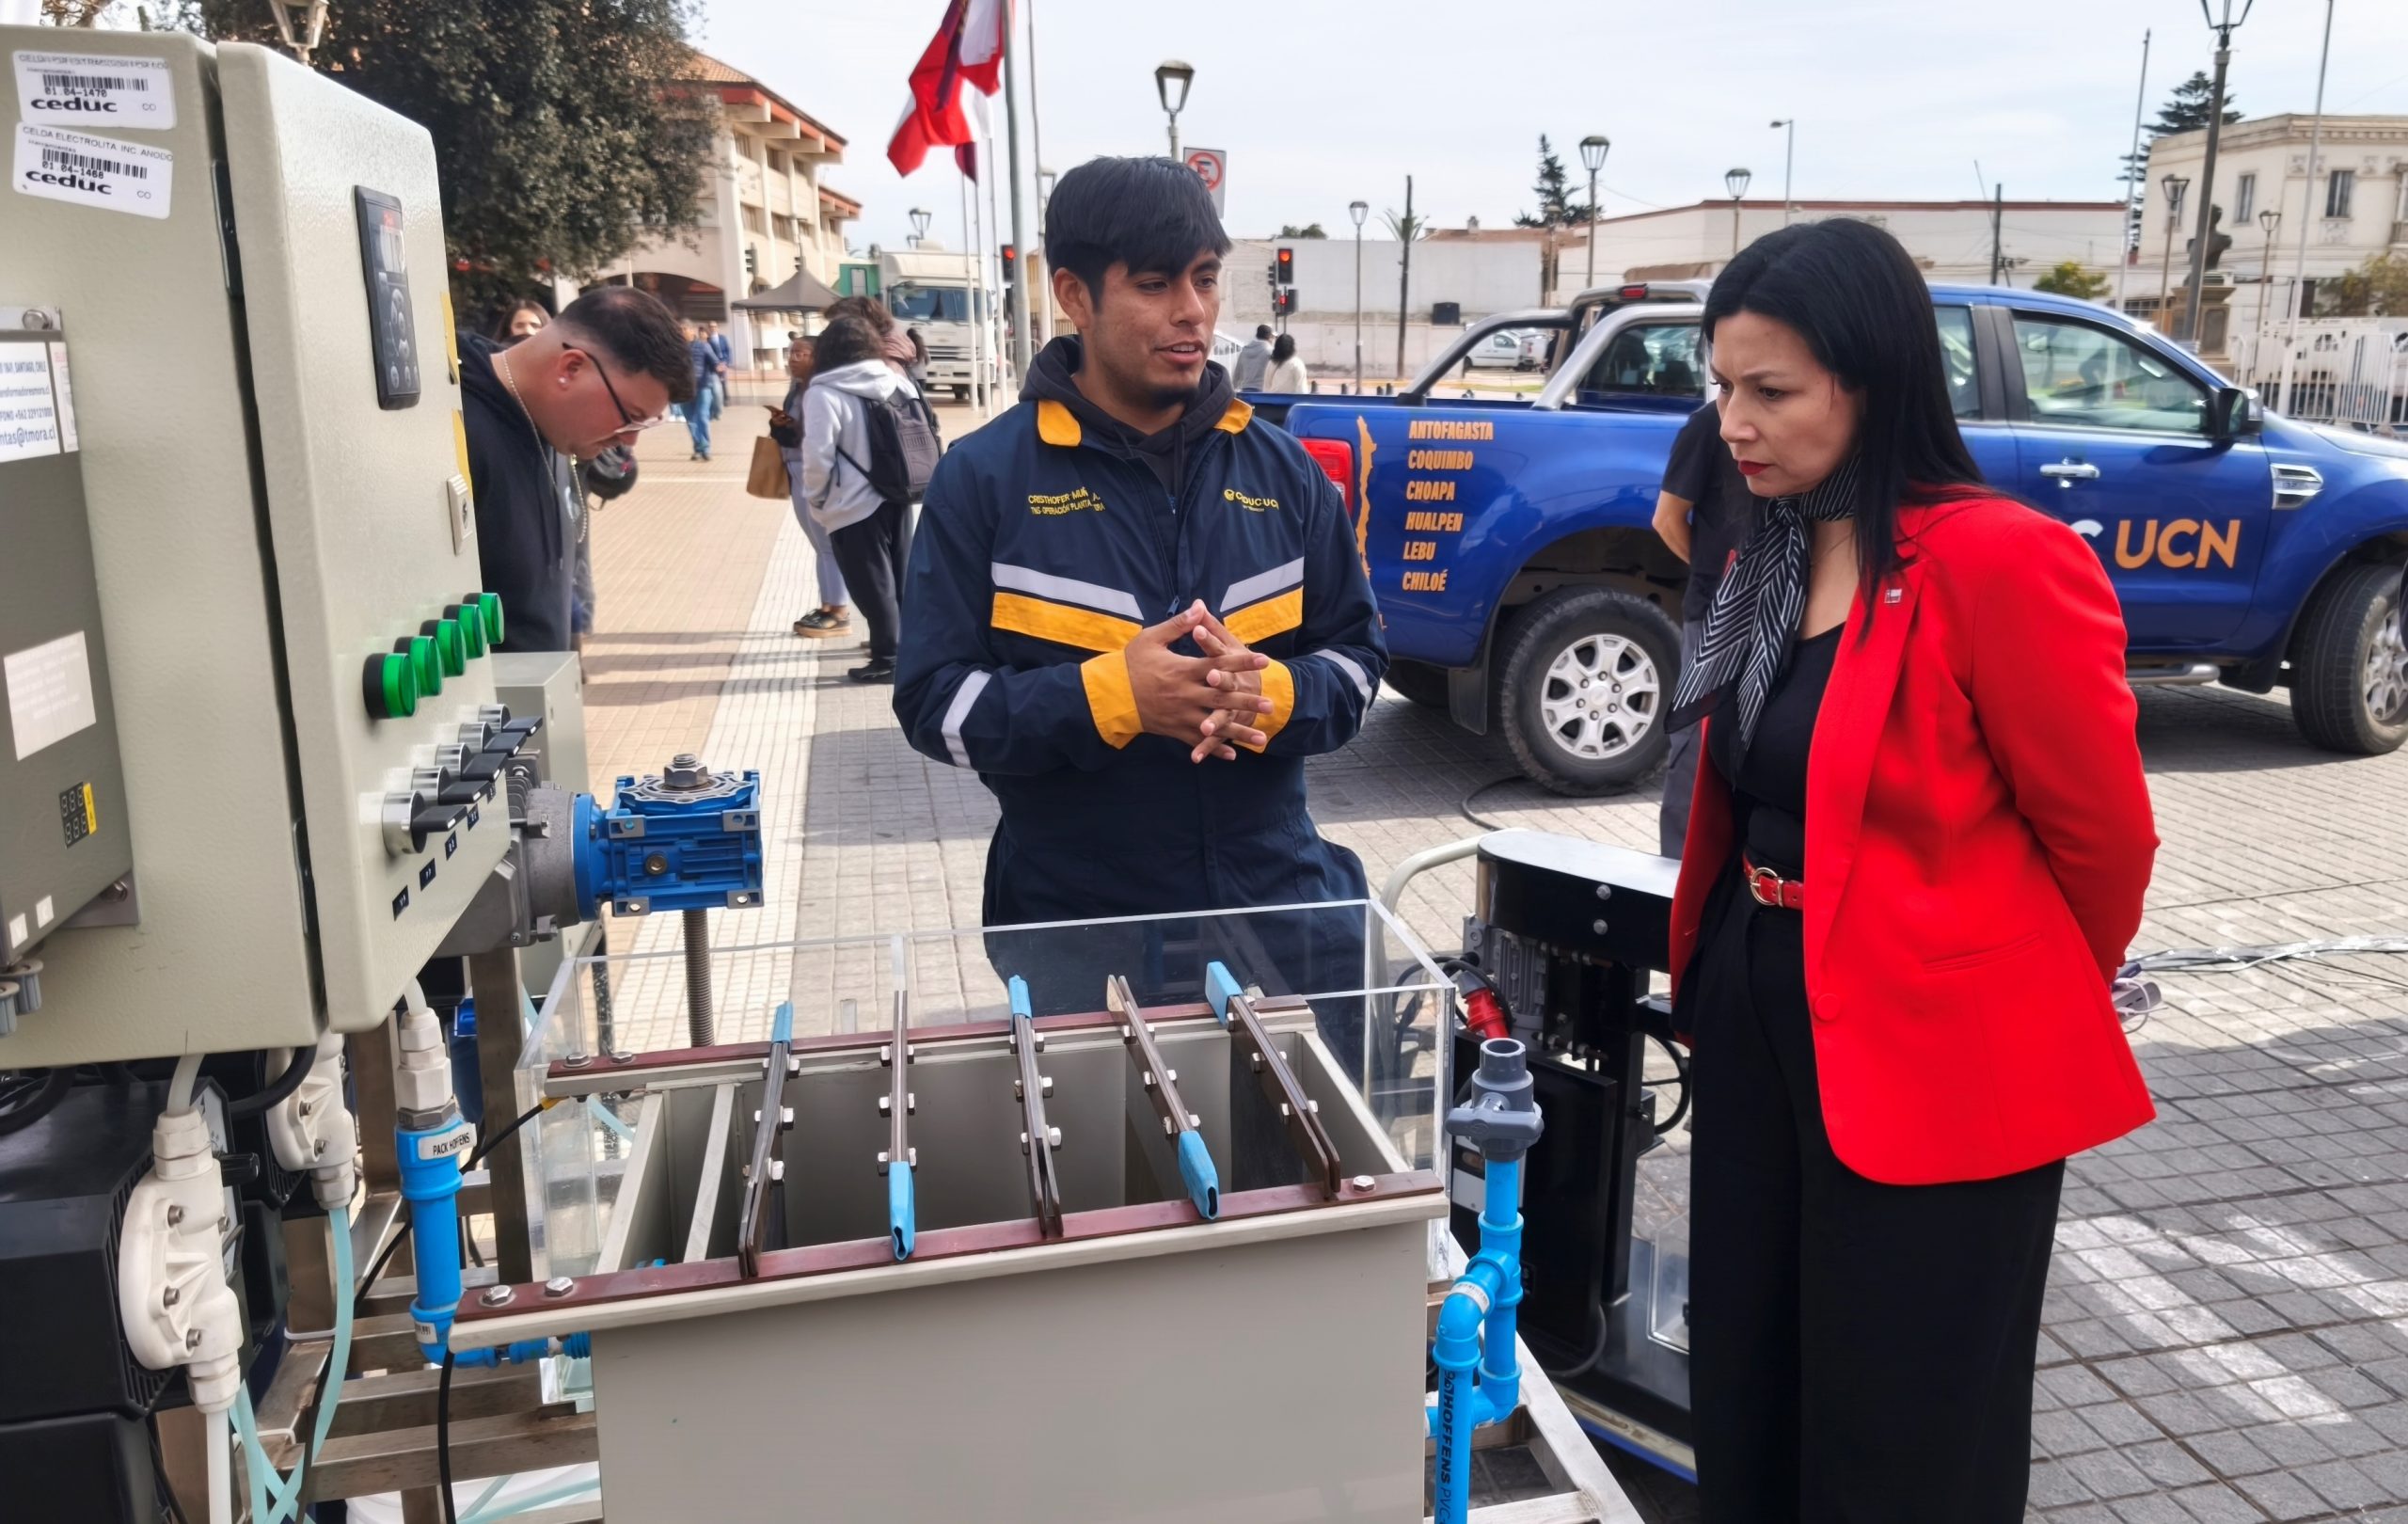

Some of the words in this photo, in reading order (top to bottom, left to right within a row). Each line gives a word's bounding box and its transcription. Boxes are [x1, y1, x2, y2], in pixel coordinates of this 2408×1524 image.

[31, 97, 118, 113] ceduc
[23, 126, 54, 137] CELDA
[55, 133, 117, 151] ELECTROLITA
[121, 145, 136, 155] INC
[25, 170, 112, 195] ceduc
[1408, 421, 1494, 440] ANTOFAGASTA
[1408, 450, 1474, 470] COQUIMBO
[1406, 481, 1455, 500] CHOAPA
[1405, 512, 1463, 532] HUALPEN
[1403, 542, 1436, 561] LEBU
[2115, 518, 2241, 568] UCN
[1402, 569, 1448, 592] CHILOÉ
[433, 1141, 449, 1155] PACK
[1440, 1396, 1454, 1484] HOFFENS
